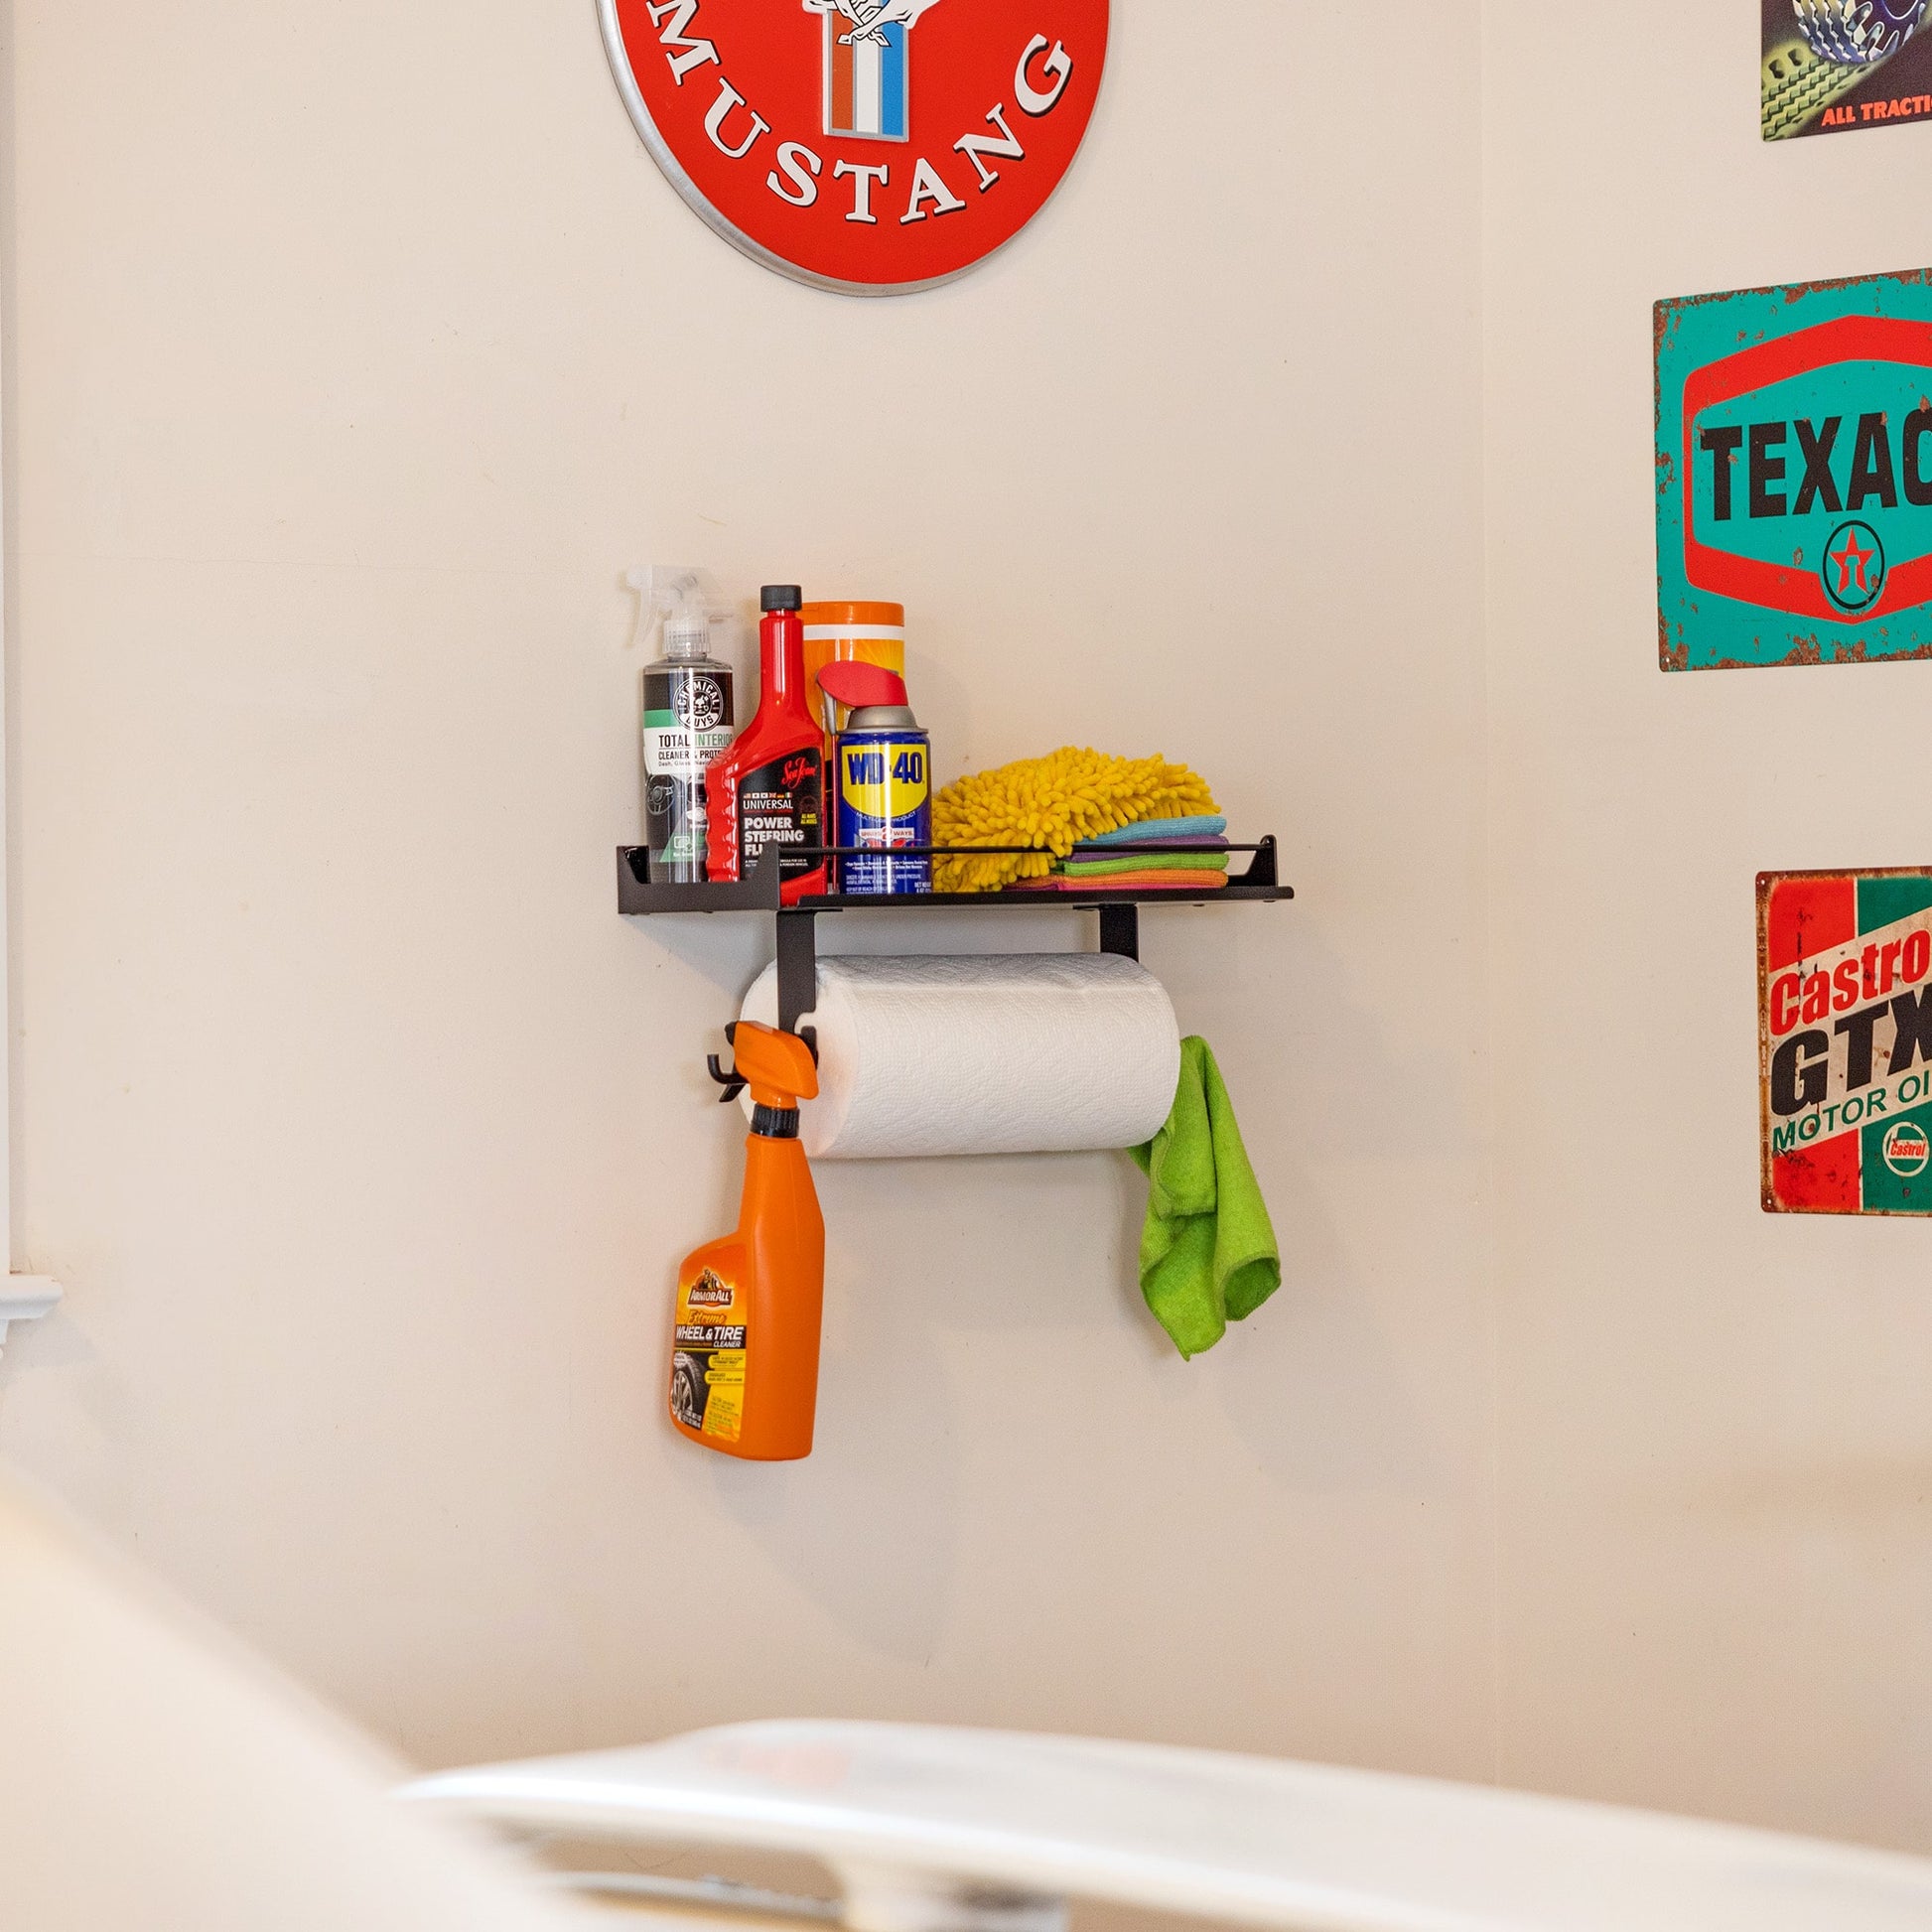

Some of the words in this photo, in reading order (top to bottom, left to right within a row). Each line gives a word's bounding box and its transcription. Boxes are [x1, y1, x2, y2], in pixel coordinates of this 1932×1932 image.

[646, 0, 1074, 224] MUSTANG
[1821, 105, 1857, 127] ALL
[1861, 94, 1932, 121] TRACTI
[658, 734, 690, 748] TOTAL
[695, 733, 733, 747] INTERIO
[658, 750, 690, 760] CLEANER
[847, 752, 923, 785] WD-40
[743, 799, 794, 810] UNIVERSAL
[744, 817, 793, 830] POWER
[744, 829, 805, 843] STEERING
[1770, 929, 1931, 1036] Castro
[1770, 981, 1932, 1117] GTX
[1772, 1087, 1887, 1153] MOTOR
[1889, 1142, 1927, 1157] Castrol
[676, 1325, 705, 1340] WHEEL
[705, 1328, 713, 1340] &
[714, 1326, 745, 1340] TIRE
